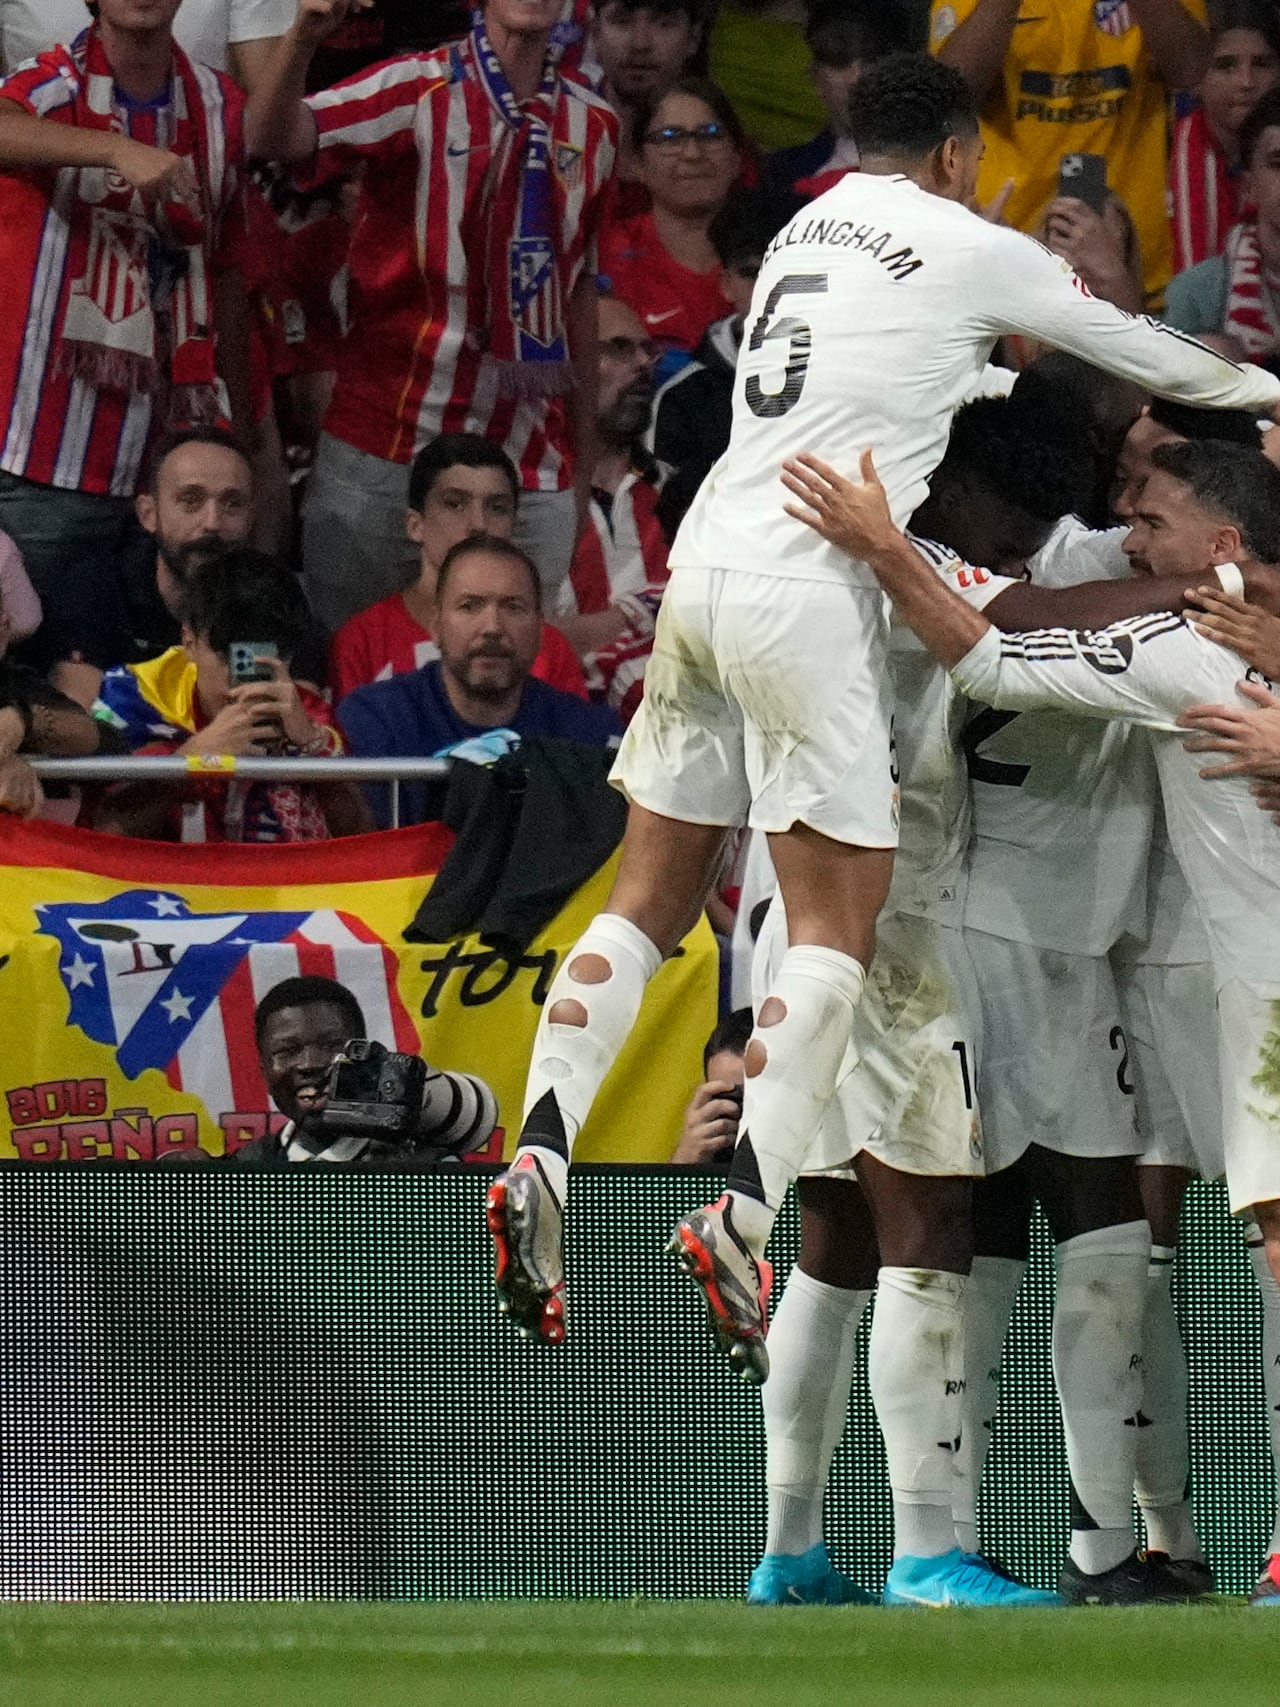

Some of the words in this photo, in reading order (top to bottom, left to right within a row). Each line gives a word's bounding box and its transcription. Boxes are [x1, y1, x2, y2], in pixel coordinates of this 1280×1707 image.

[761, 219, 925, 281] ELLINGHAM
[744, 272, 829, 419] 5
[6, 1078, 108, 1126] 2016
